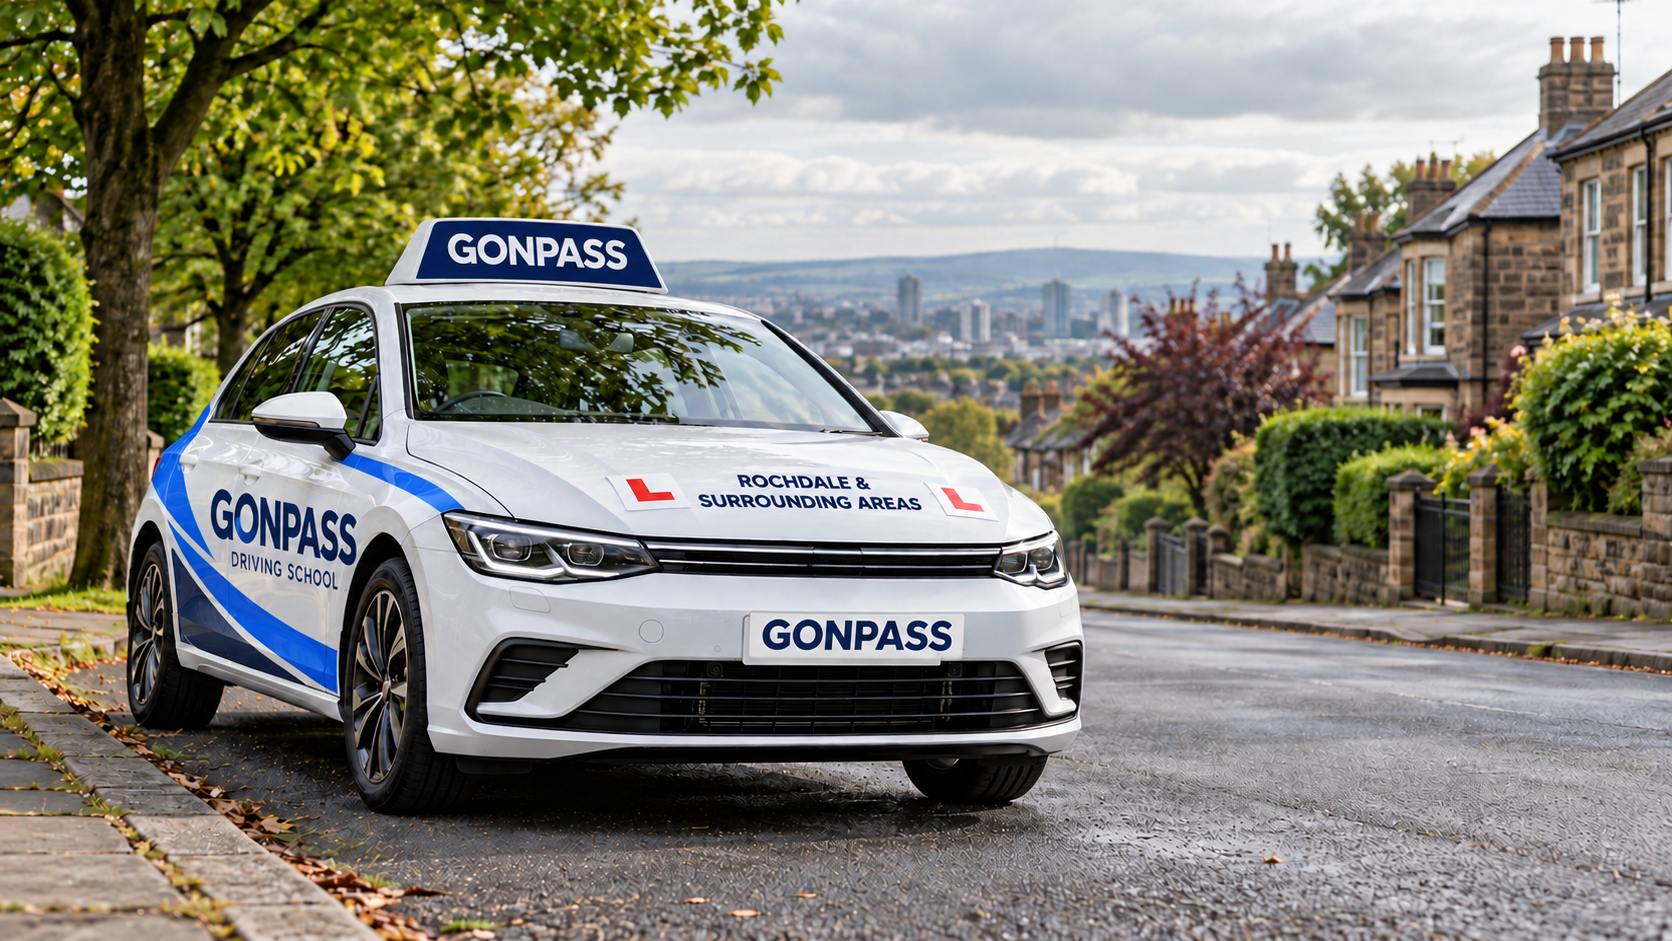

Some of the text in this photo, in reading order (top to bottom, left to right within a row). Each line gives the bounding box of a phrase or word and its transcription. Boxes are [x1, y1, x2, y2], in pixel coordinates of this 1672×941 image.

[447, 233, 628, 270] GONPASS
[625, 478, 676, 502] L
[736, 474, 871, 491] ROCHDALE &
[698, 494, 923, 511] SURROUNDING AREAS
[940, 487, 985, 513] L
[210, 489, 357, 566] GONPASS
[231, 551, 338, 590] DRIVING SCHOOL
[762, 619, 953, 651] GONPASS
